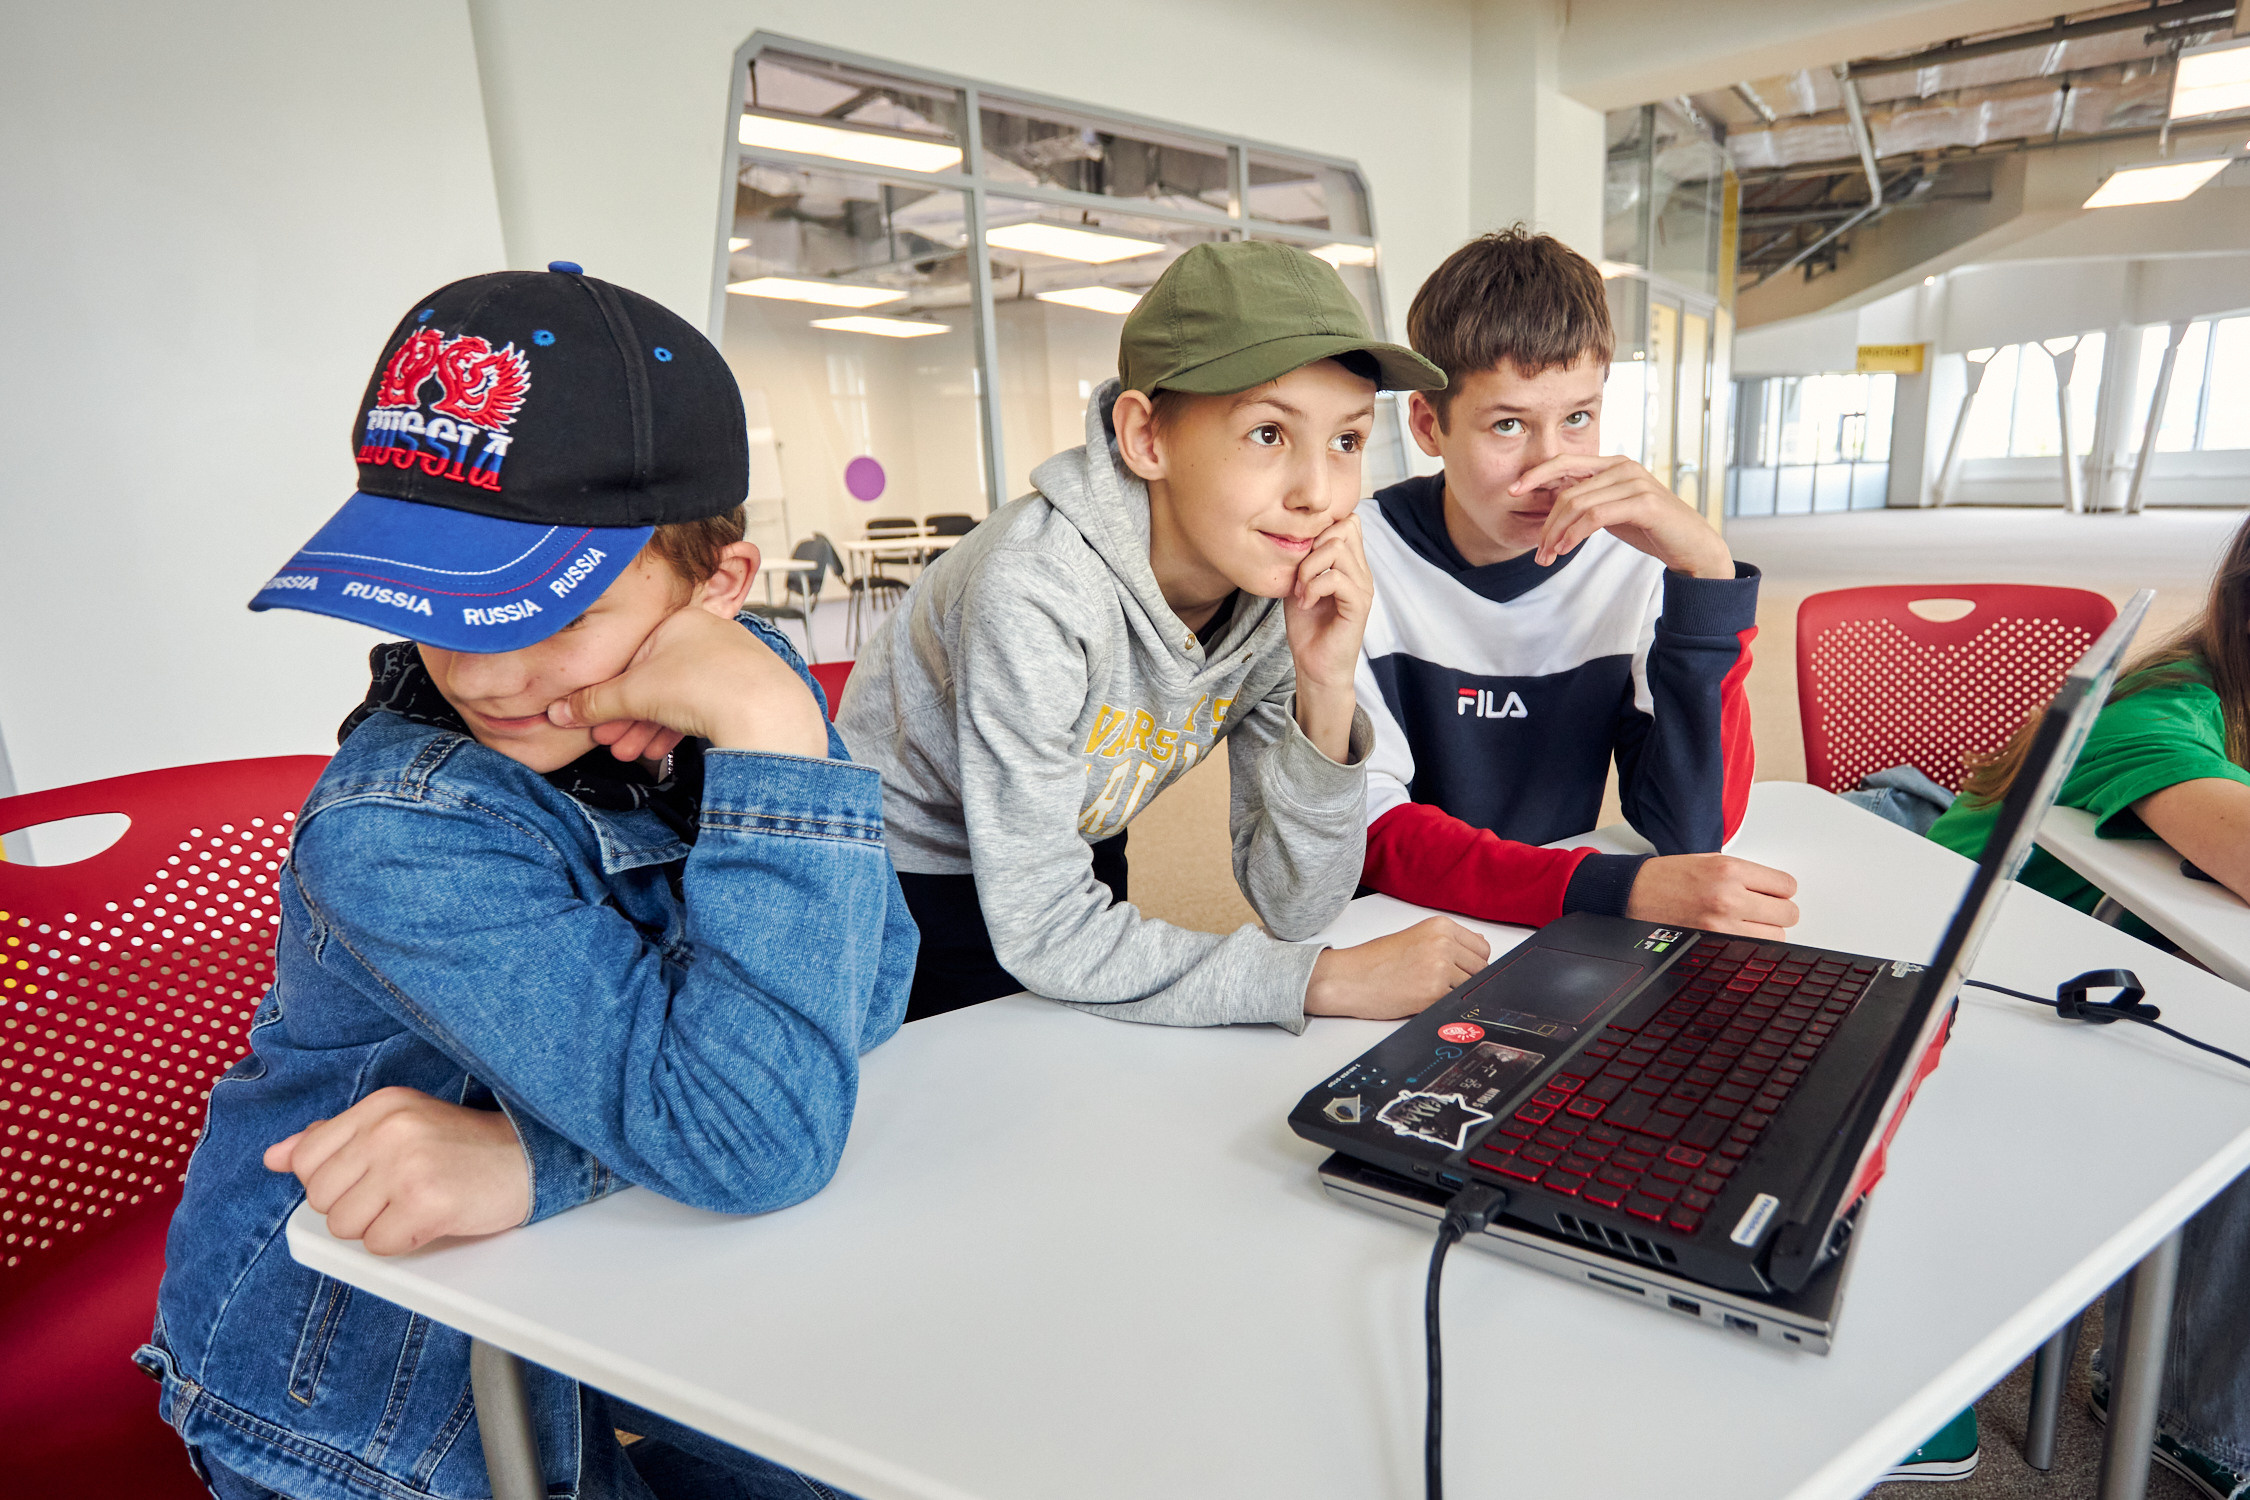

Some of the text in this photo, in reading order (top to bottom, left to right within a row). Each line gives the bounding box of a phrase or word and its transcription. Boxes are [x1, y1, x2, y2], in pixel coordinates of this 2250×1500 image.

[356, 410, 513, 492] RUSSIA
[342, 581, 432, 616] RUSSIA
[463, 598, 542, 627] RUSSIA
[549, 547, 606, 599] RUSSIA
[1457, 687, 1528, 718] FILA
[1477, 1087, 1500, 1104] NITRO
